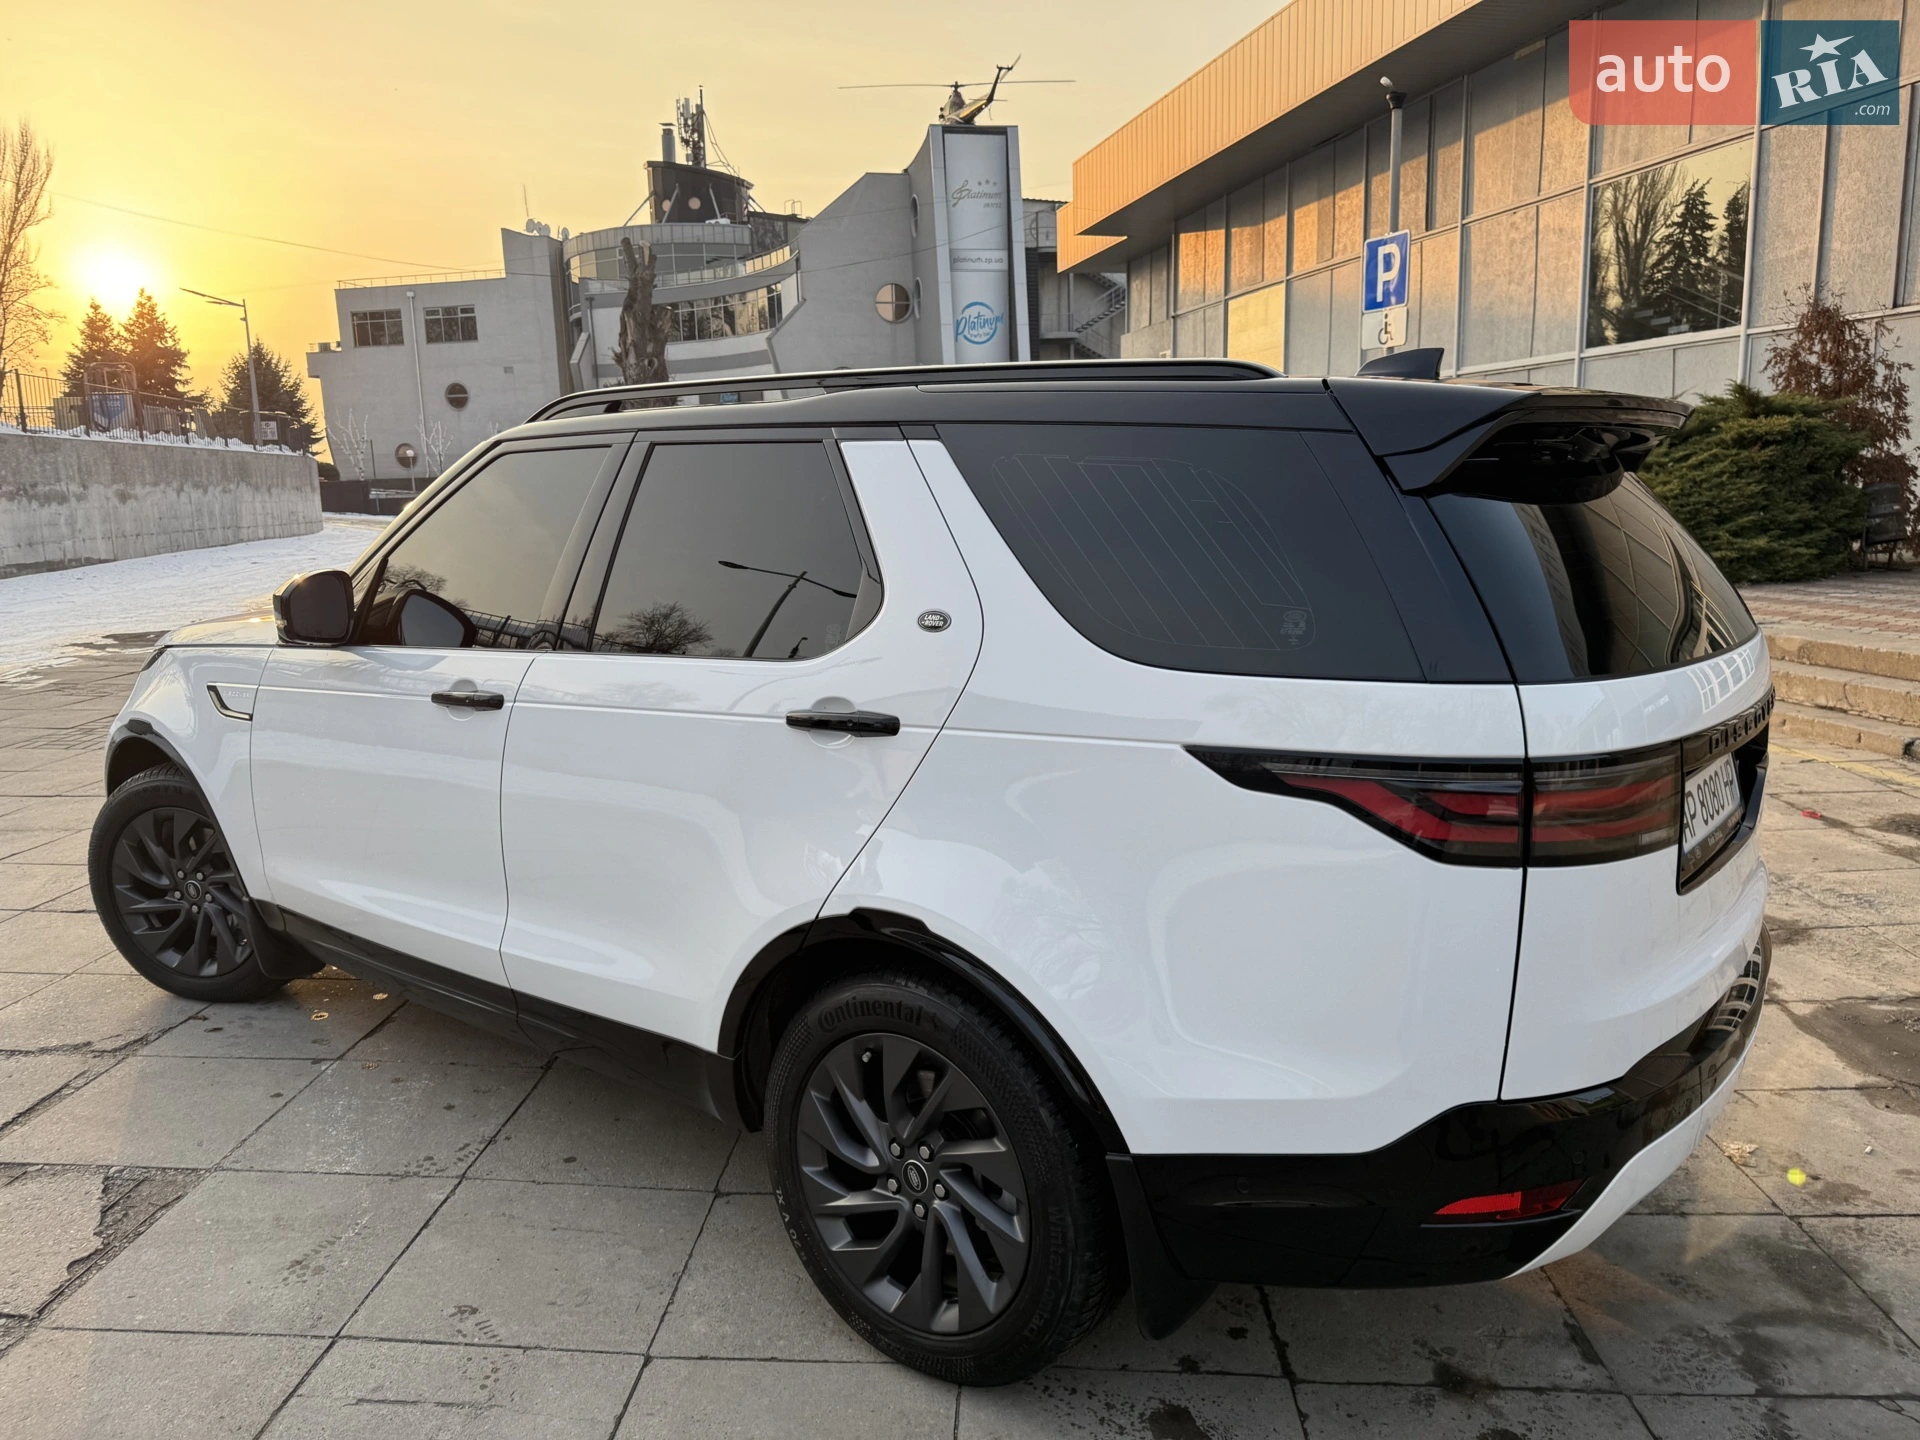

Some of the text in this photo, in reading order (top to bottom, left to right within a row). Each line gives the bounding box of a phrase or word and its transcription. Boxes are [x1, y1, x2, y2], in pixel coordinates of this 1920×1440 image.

[952, 256, 1004, 265] platinum.zp.ua
[1376, 243, 1401, 303] P
[955, 311, 1005, 343] Platinum
[1683, 790, 1697, 844] AP
[1696, 770, 1725, 827] 8080
[1720, 758, 1735, 806] HP
[817, 996, 924, 1034] Continental
